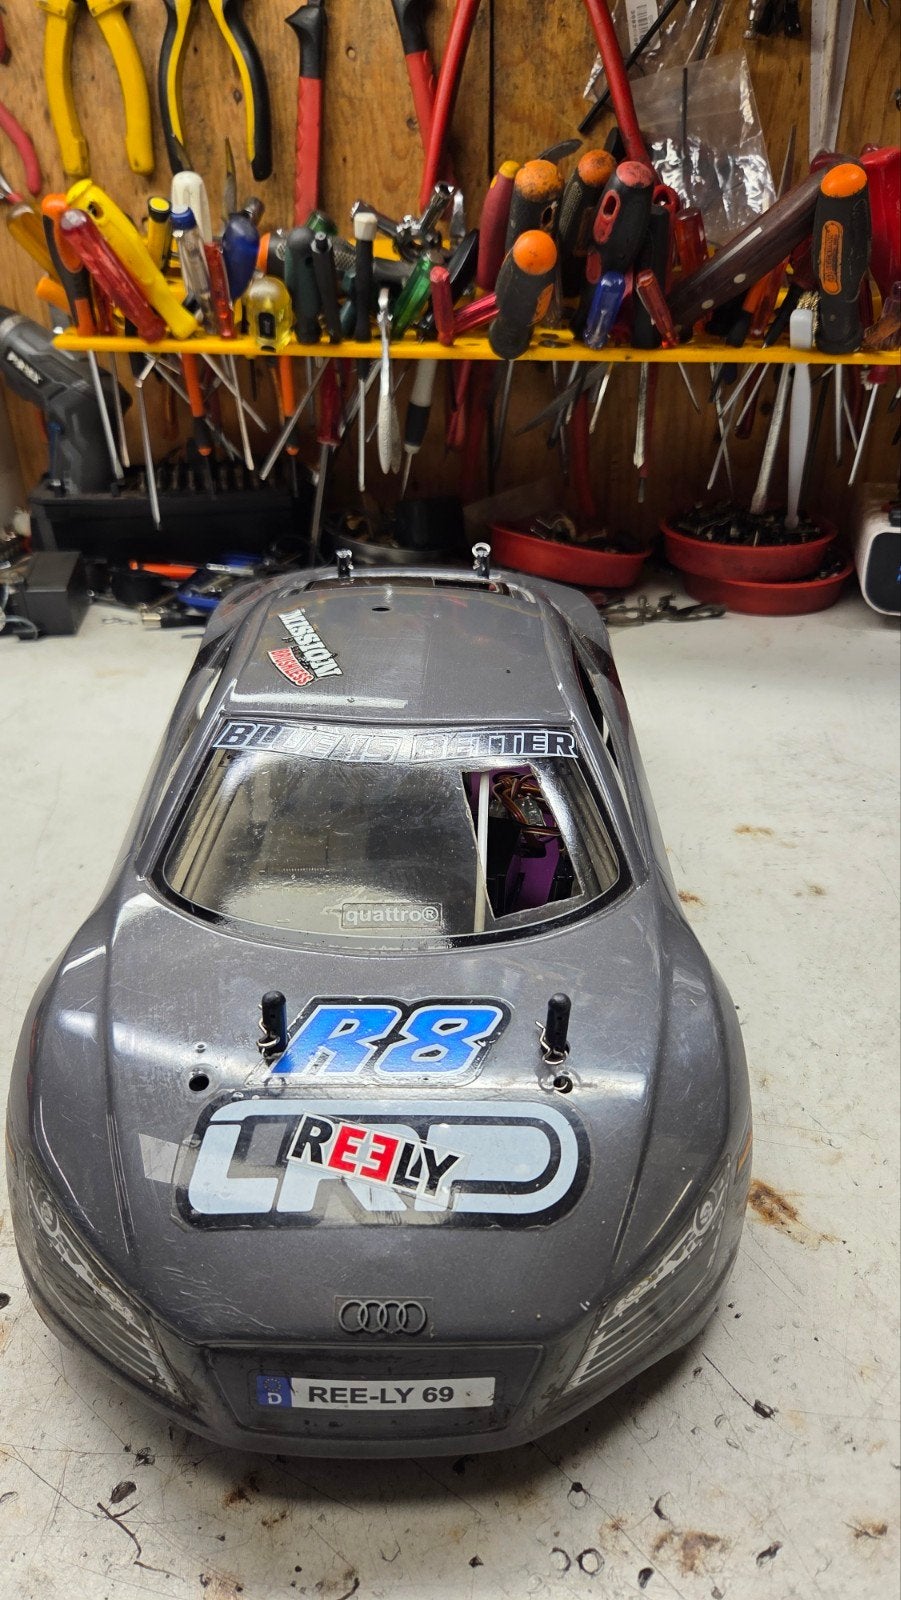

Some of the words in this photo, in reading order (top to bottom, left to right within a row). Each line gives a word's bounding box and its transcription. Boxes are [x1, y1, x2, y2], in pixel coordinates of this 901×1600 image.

[270, 647, 314, 684] BRUSHLESS
[278, 608, 343, 679] MISSION
[213, 721, 342, 759] BLUE
[411, 730, 579, 764] BETTER
[272, 1004, 504, 1076] R8
[287, 1113, 464, 1198] REELY
[268, 1392, 283, 1405] D
[308, 1386, 415, 1404] REE-LY
[421, 1386, 454, 1403] 69
